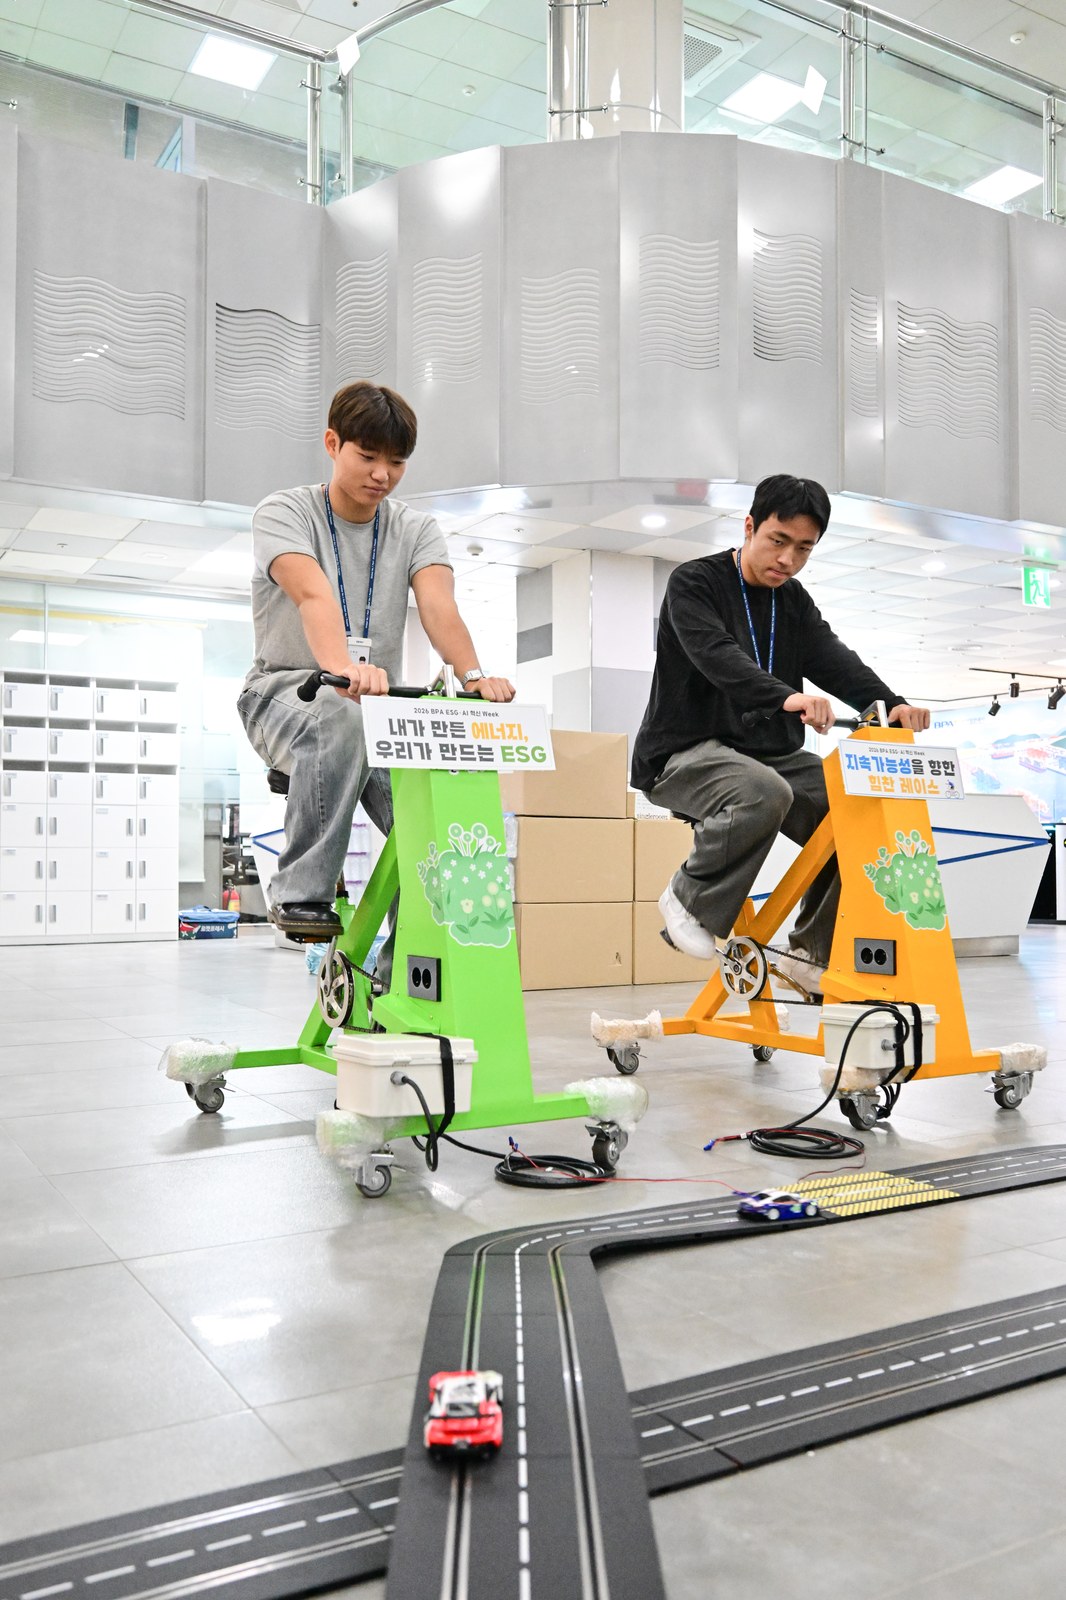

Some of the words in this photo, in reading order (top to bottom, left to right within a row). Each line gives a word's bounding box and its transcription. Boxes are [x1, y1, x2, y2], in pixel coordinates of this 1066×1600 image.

[388, 718, 425, 737] 내가
[430, 720, 466, 738] 만든
[471, 721, 528, 742] 에너지,
[375, 740, 432, 760] 우리가
[439, 743, 494, 762] 만드는
[500, 745, 546, 763] ESG
[845, 753, 925, 775] 지속가능성을
[928, 759, 955, 777] 향한
[868, 775, 894, 792] 힘찬
[899, 777, 940, 795] 레이스
